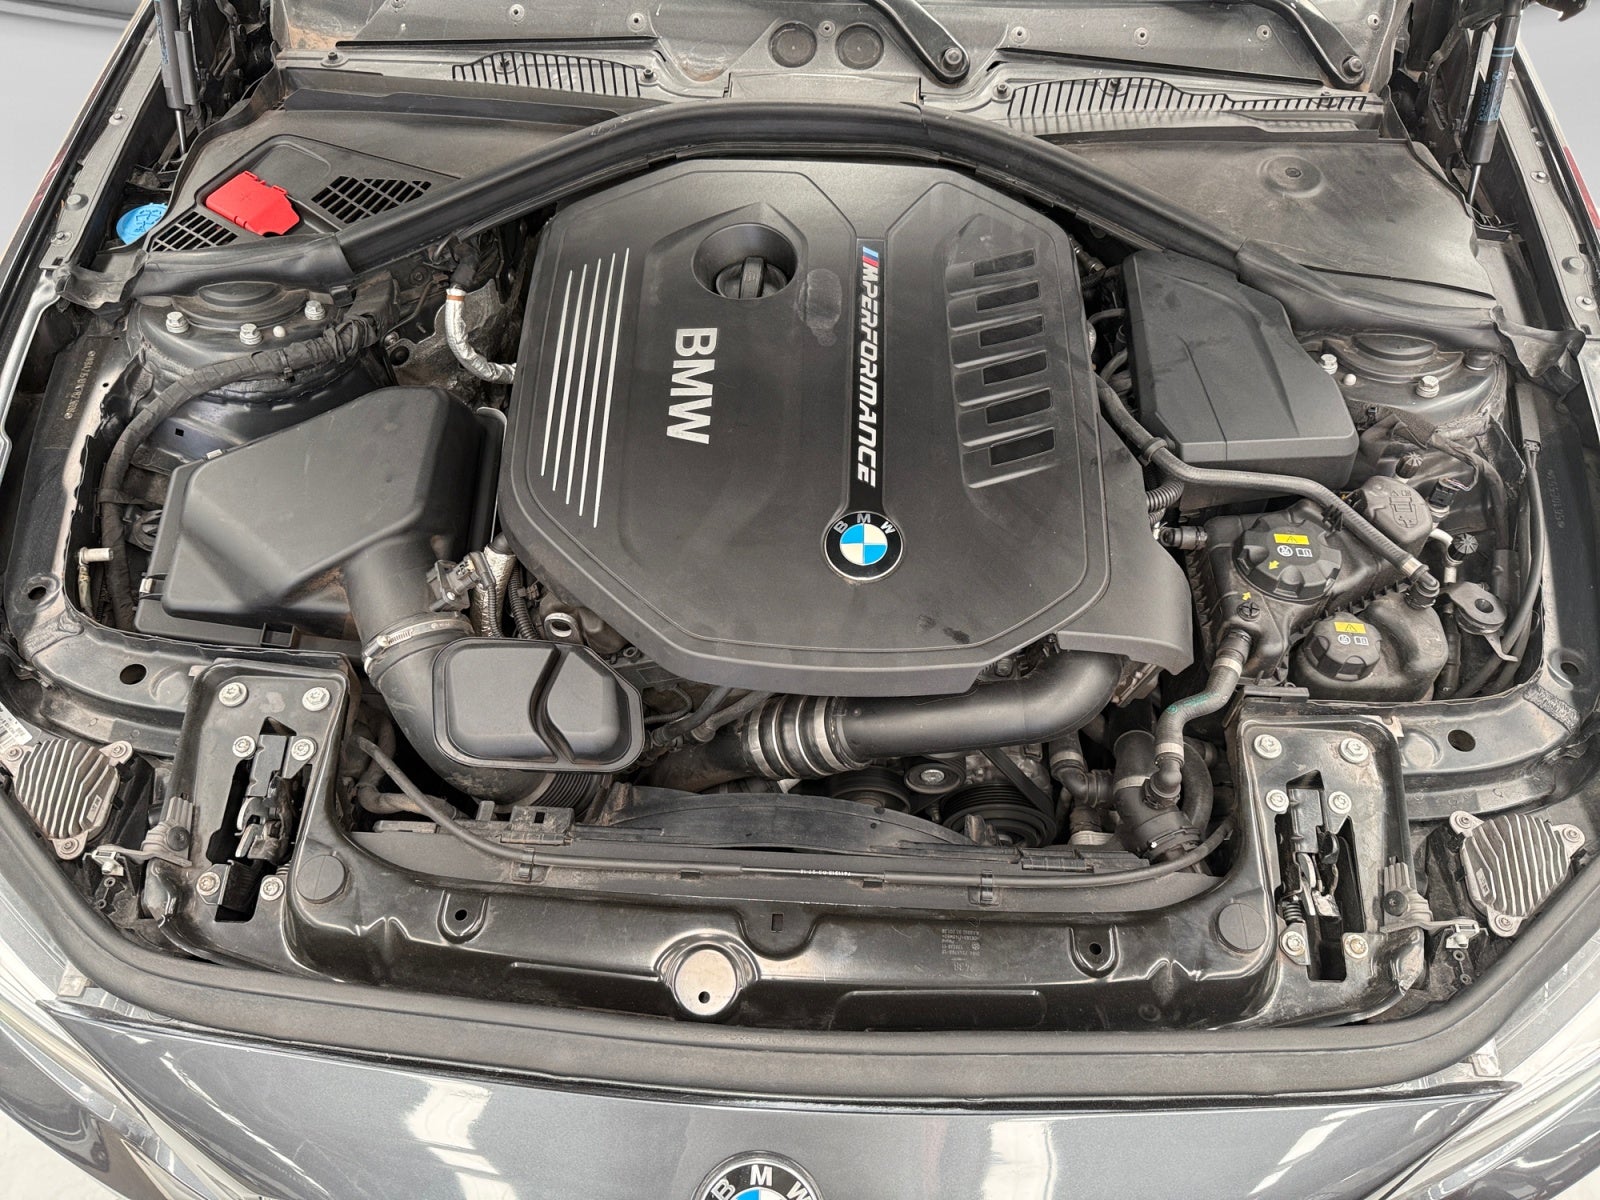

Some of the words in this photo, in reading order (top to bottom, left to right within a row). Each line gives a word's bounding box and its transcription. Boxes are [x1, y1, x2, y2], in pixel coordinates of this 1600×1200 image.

[666, 327, 718, 444] BMW
[857, 281, 879, 488] PERFORMANCE
[833, 513, 896, 535] BMW
[710, 1164, 812, 1200] BMW
